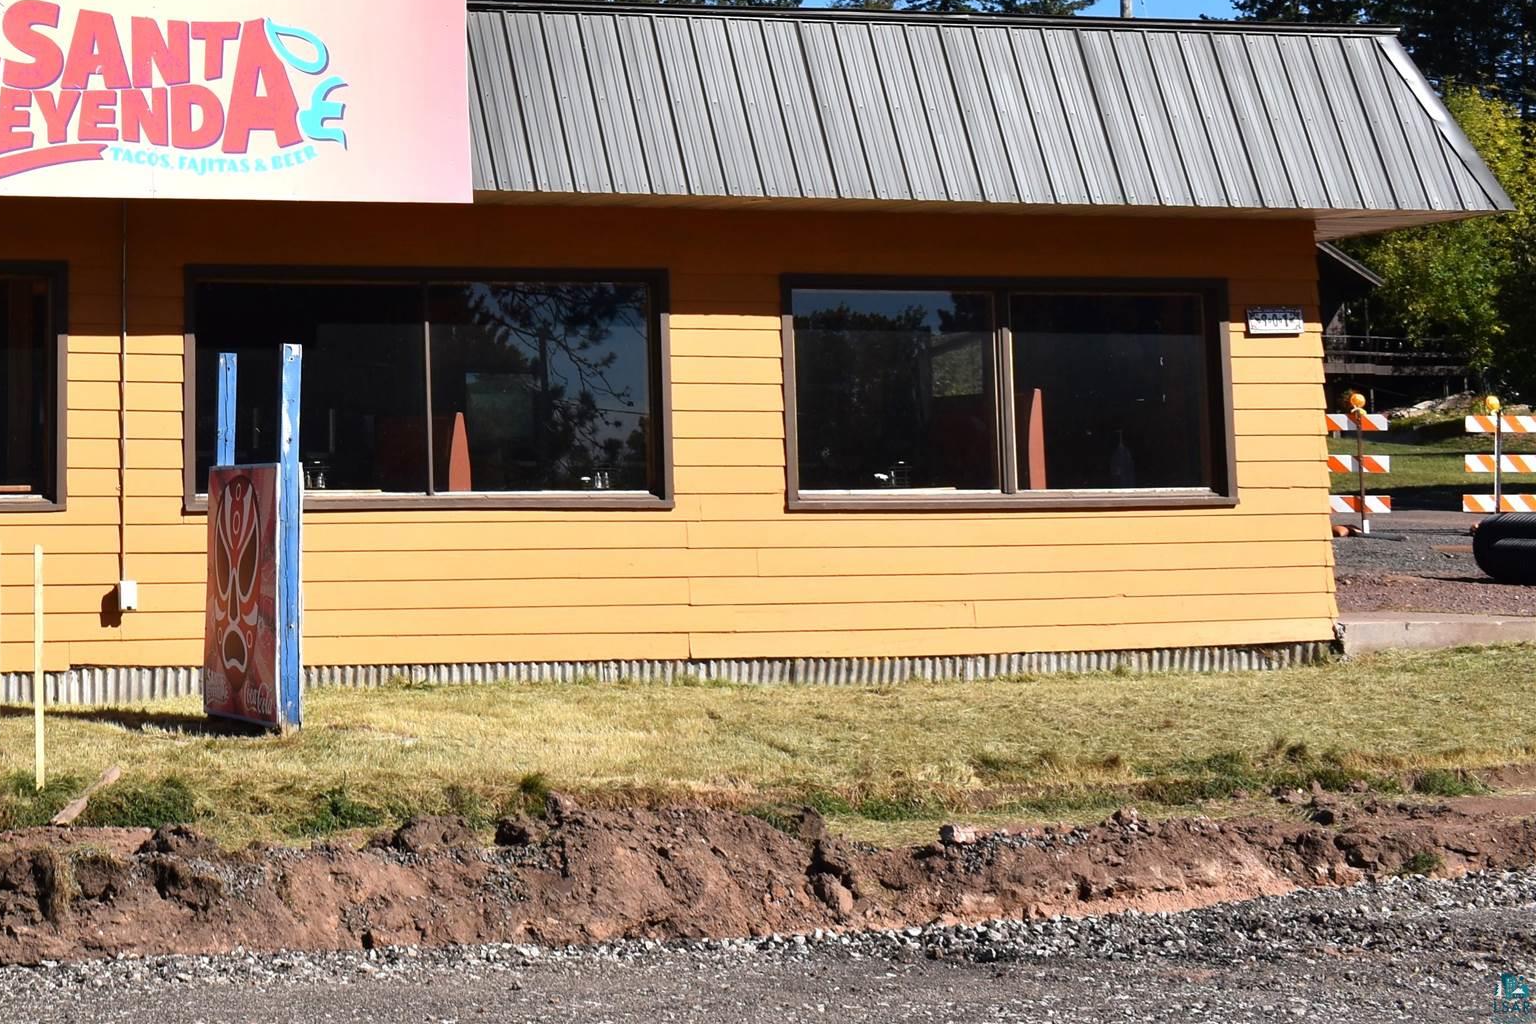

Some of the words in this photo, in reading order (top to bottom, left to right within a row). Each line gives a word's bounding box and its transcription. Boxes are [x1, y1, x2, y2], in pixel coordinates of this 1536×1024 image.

[178, 156, 250, 175] FAJITAS
[255, 158, 268, 172] &
[272, 145, 318, 170] BEER
